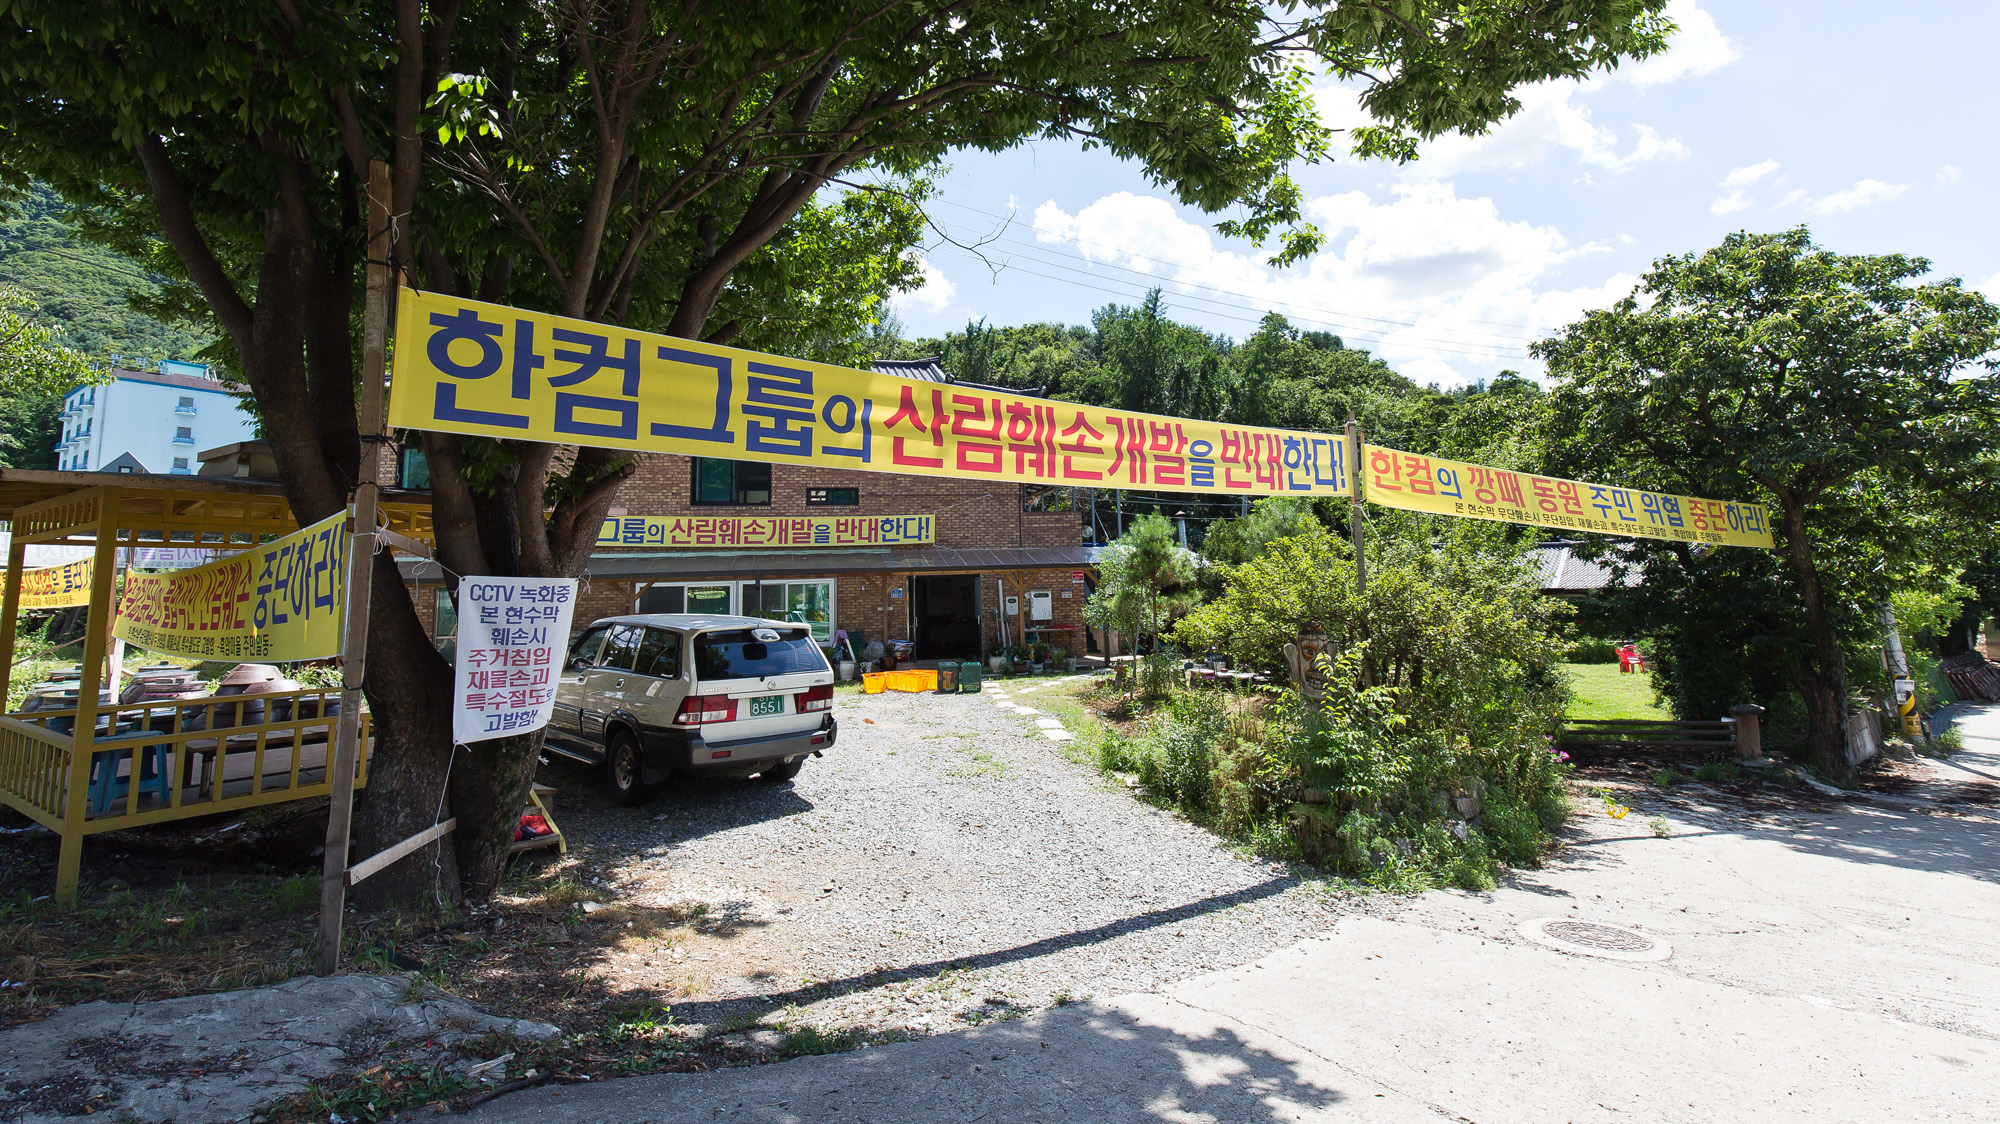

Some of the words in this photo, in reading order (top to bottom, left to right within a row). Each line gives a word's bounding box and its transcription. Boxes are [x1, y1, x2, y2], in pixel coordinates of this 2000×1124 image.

[425, 308, 873, 464] 한컴그룹의
[882, 385, 1216, 488] 산림훼손개발을
[1219, 428, 1346, 493] 반대한다!
[1370, 449, 1463, 500] 한컴의
[1467, 466, 1527, 509] 깡패
[1532, 477, 1584, 516] 동원
[1590, 485, 1636, 523] 주민
[1641, 493, 1685, 528] 위협
[1688, 499, 1767, 536] 중단하라!
[1454, 501, 1465, 513] 본
[1467, 503, 1495, 516] 현수막
[669, 517, 831, 545] 산림훼손개발을
[835, 516, 930, 543] 반대한다!
[254, 521, 346, 630] 중단하라!
[469, 584, 515, 602] CCTV
[519, 584, 571, 603] 녹화중
[480, 605, 499, 625] 본
[505, 605, 560, 625] 현수막
[490, 627, 547, 646] 훼손시
[467, 647, 552, 668] 주거침입
[466, 667, 550, 690] 재물손괴
[752, 700, 781, 714] 8551
